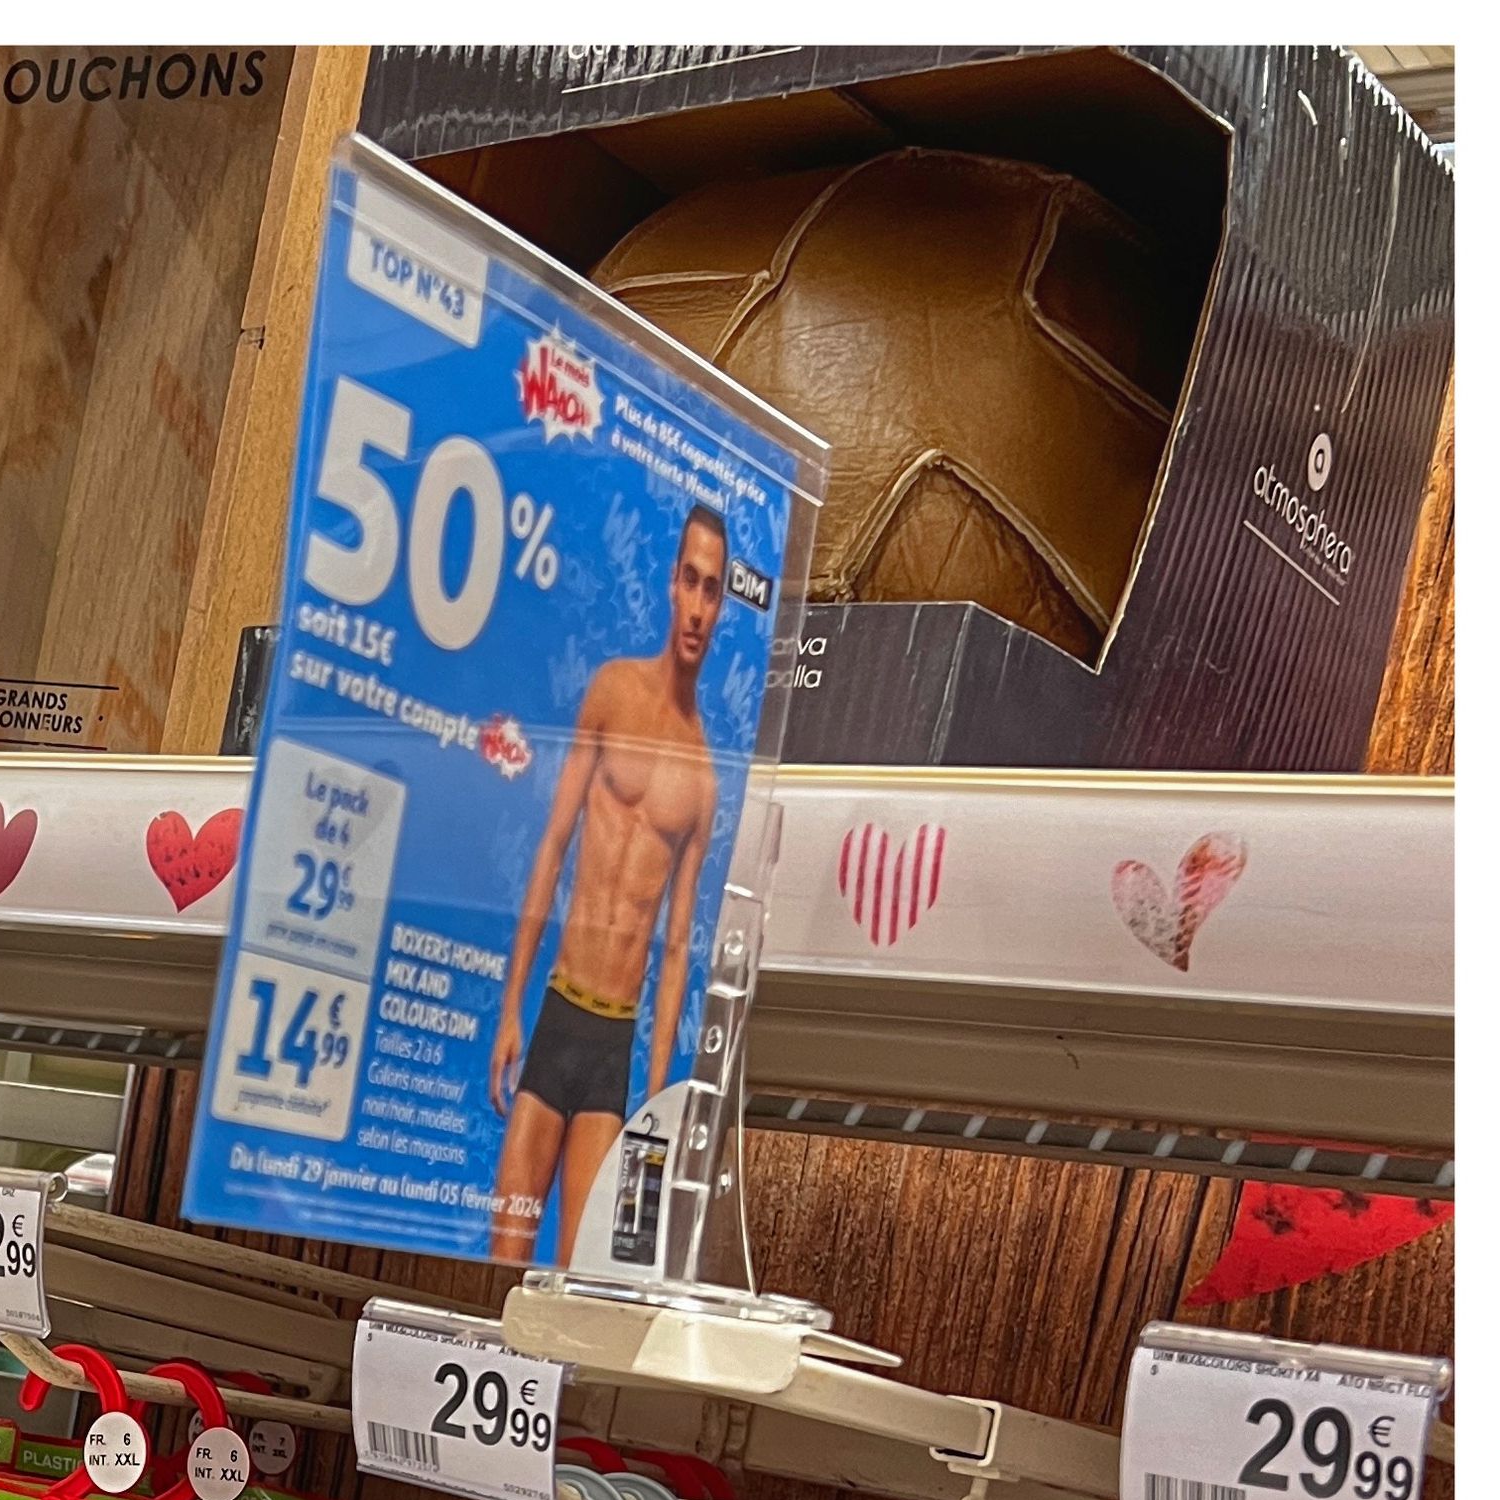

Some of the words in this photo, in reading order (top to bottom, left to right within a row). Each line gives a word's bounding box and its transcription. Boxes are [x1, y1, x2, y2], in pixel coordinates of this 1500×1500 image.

[370, 238, 412, 285] TOP
[1253, 463, 1353, 574] atmosphera
[732, 563, 768, 605] DIM
[298, 602, 347, 649] soit
[349, 615, 398, 667] 15€
[290, 651, 335, 689] sur
[335, 670, 398, 717] votre
[399, 696, 480, 750] compte
[386, 957, 416, 990] MIX
[418, 970, 450, 999] AND
[391, 924, 450, 963] BOXERS
[449, 940, 507, 981] HOMME
[379, 994, 449, 1034] COLOURS
[449, 1014, 478, 1042] DIM
[230, 1146, 253, 1171] Du
[257, 1149, 300, 1178] lundi
[301, 1157, 321, 1181] 29
[321, 1160, 377, 1191] janvier
[379, 1176, 398, 1194] au
[400, 1176, 438, 1202] lundi
[439, 1180, 458, 1203] 05
[460, 1185, 505, 1211] février
[507, 1194, 542, 1219] 2024
[6, 1240, 36, 1278] 99
[431, 1362, 508, 1446] 29
[510, 1408, 551, 1452] 99
[115, 1453, 141, 1467] XXL
[122, 1432, 132, 1447] 6
[1238, 1398, 1352, 1499] 29
